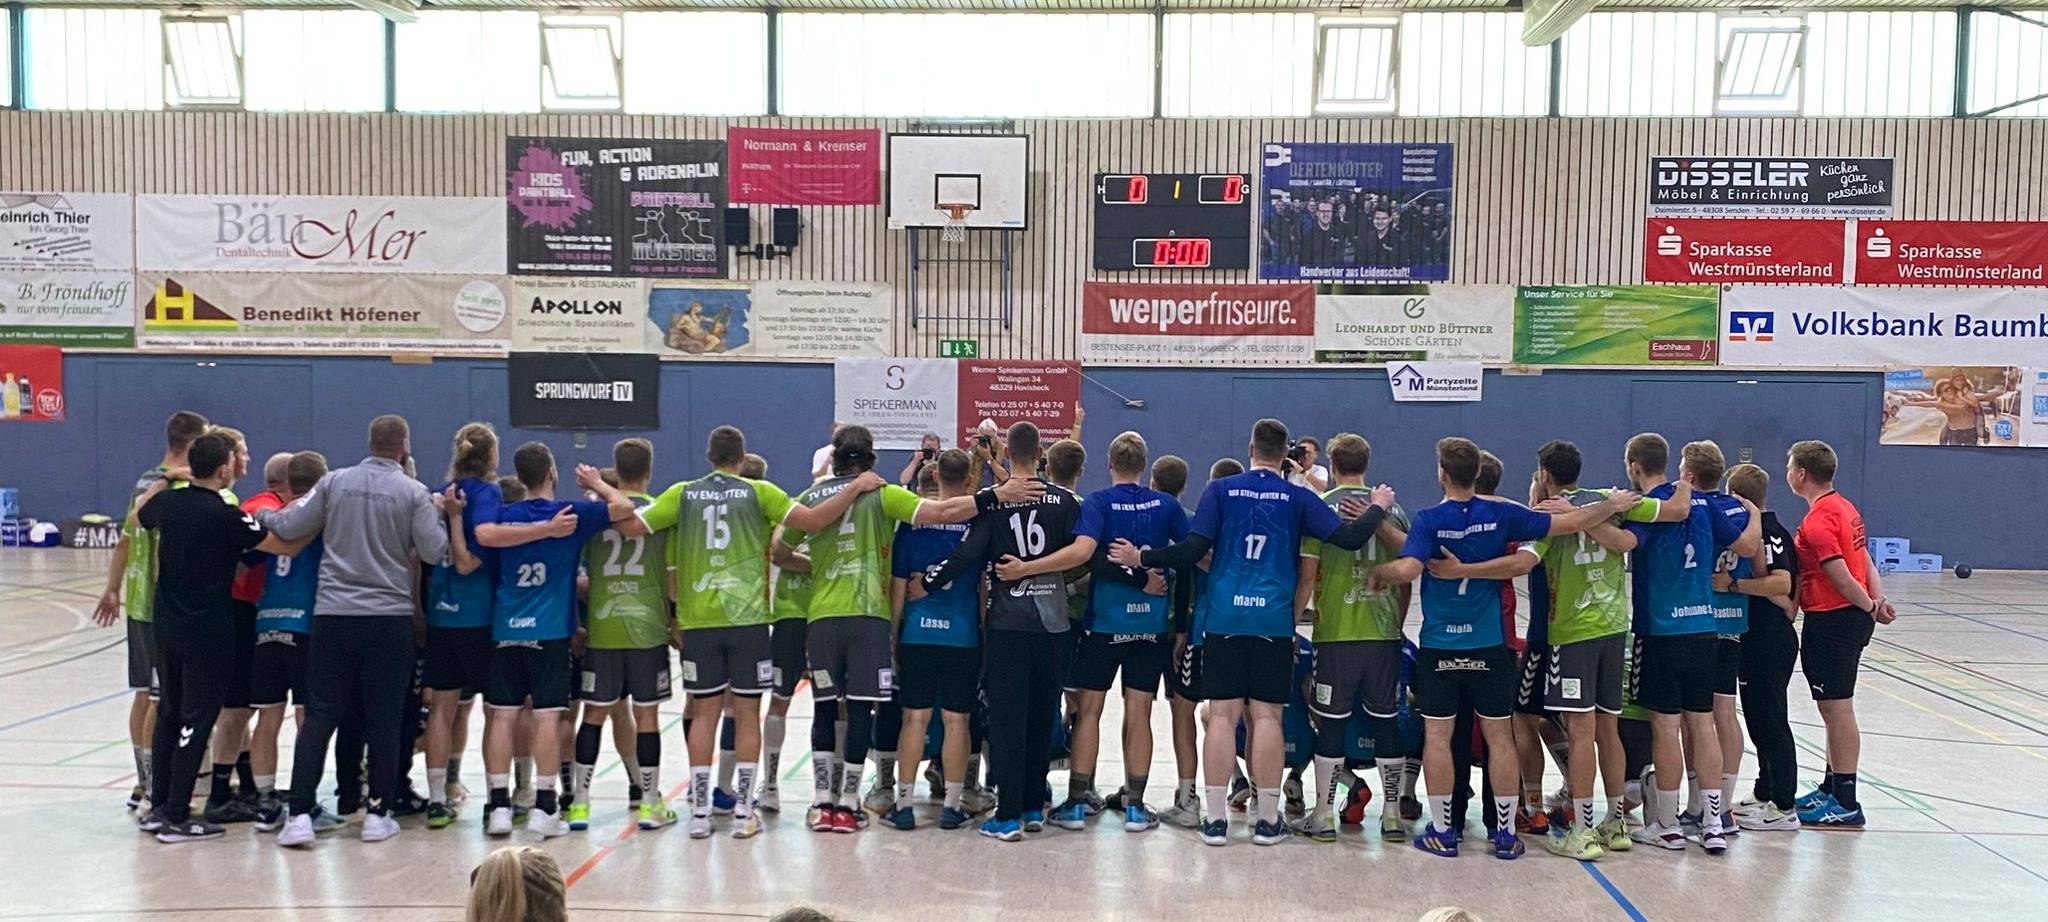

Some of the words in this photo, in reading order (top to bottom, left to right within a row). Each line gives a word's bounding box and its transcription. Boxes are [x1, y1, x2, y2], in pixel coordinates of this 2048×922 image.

[743, 139, 797, 151] Normann
[803, 141, 812, 151] &
[818, 141, 868, 152] Kremser
[561, 150, 593, 167] FUN,
[599, 147, 652, 165] ACTION
[638, 162, 720, 182] ADRENALIN
[1820, 161, 1860, 177] Küchen
[530, 172, 563, 187] KIDS
[1840, 174, 1868, 187] ganz
[518, 187, 576, 198] PAINTBALL
[1097, 186, 1105, 194] H
[1129, 177, 1146, 202] 0
[1223, 176, 1241, 202] 0
[1241, 185, 1250, 194] G
[1657, 187, 1702, 200] Möbel
[1711, 188, 1720, 200] &
[1728, 187, 1809, 202] Einrichtung
[1827, 181, 1886, 202] persönlich
[630, 191, 715, 208] PAINTBALL
[54, 211, 91, 224] Thier
[216, 246, 293, 258] Dentaltechnik
[631, 238, 716, 261] MÜNSTER
[1153, 240, 1209, 266] 0:00
[1689, 241, 1772, 258] Sparkasse
[1899, 243, 1983, 260] Sparkasse
[1300, 267, 1343, 278] Handwerker
[1345, 268, 1358, 277] aus
[1360, 267, 1410, 278] Leidenschaft!
[1689, 260, 1833, 277] Westmünsterland
[1899, 261, 2043, 281] Westmünsterland
[18, 282, 36, 300] B.
[570, 280, 576, 288] &
[578, 280, 637, 288] RESTAURANT
[1524, 290, 1549, 298] Unser
[1550, 290, 1584, 298] Service
[1586, 290, 1598, 298] für
[1600, 290, 1614, 298] Sie
[16, 304, 34, 314] nur
[37, 304, 60, 314] vom
[530, 296, 622, 314] APOLLON
[243, 306, 333, 323] Benedikt
[340, 305, 421, 323] Höfener
[517, 319, 571, 327] Griechische
[574, 319, 635, 328] Spezialitäten
[1335, 323, 1406, 334] LEONHARDT
[1410, 324, 1436, 334] UND
[1438, 322, 1494, 335] BÜTTNER
[1792, 311, 1944, 337] Volksbank
[1364, 335, 1411, 346] SCHÖNE
[1415, 335, 1463, 347] GÄRTEN
[1652, 342, 1691, 351] Eschhaus
[998, 366, 1045, 374] Spiekermann
[1045, 366, 1068, 374] GmbH
[1031, 375, 1041, 383] 34
[1426, 377, 1478, 386] Partyzelte
[535, 382, 612, 399] SPRUNGWURF
[615, 384, 631, 399] TV
[1014, 384, 1050, 392] Havixbeck
[853, 399, 937, 411] SPIEKERMANN
[1043, 410, 1060, 418] 7-29
[686, 490, 699, 500] TV
[808, 489, 821, 500] TV
[702, 503, 731, 549] 15
[1009, 509, 1046, 558] 16
[602, 528, 645, 577] 22
[1244, 533, 1266, 561] 17
[1684, 543, 1697, 569] 2
[276, 555, 292, 577] 9
[517, 562, 546, 587] 23
[1233, 594, 1266, 608] Mario
[1671, 603, 1713, 618] Johannes
[919, 616, 950, 630] Lasse
